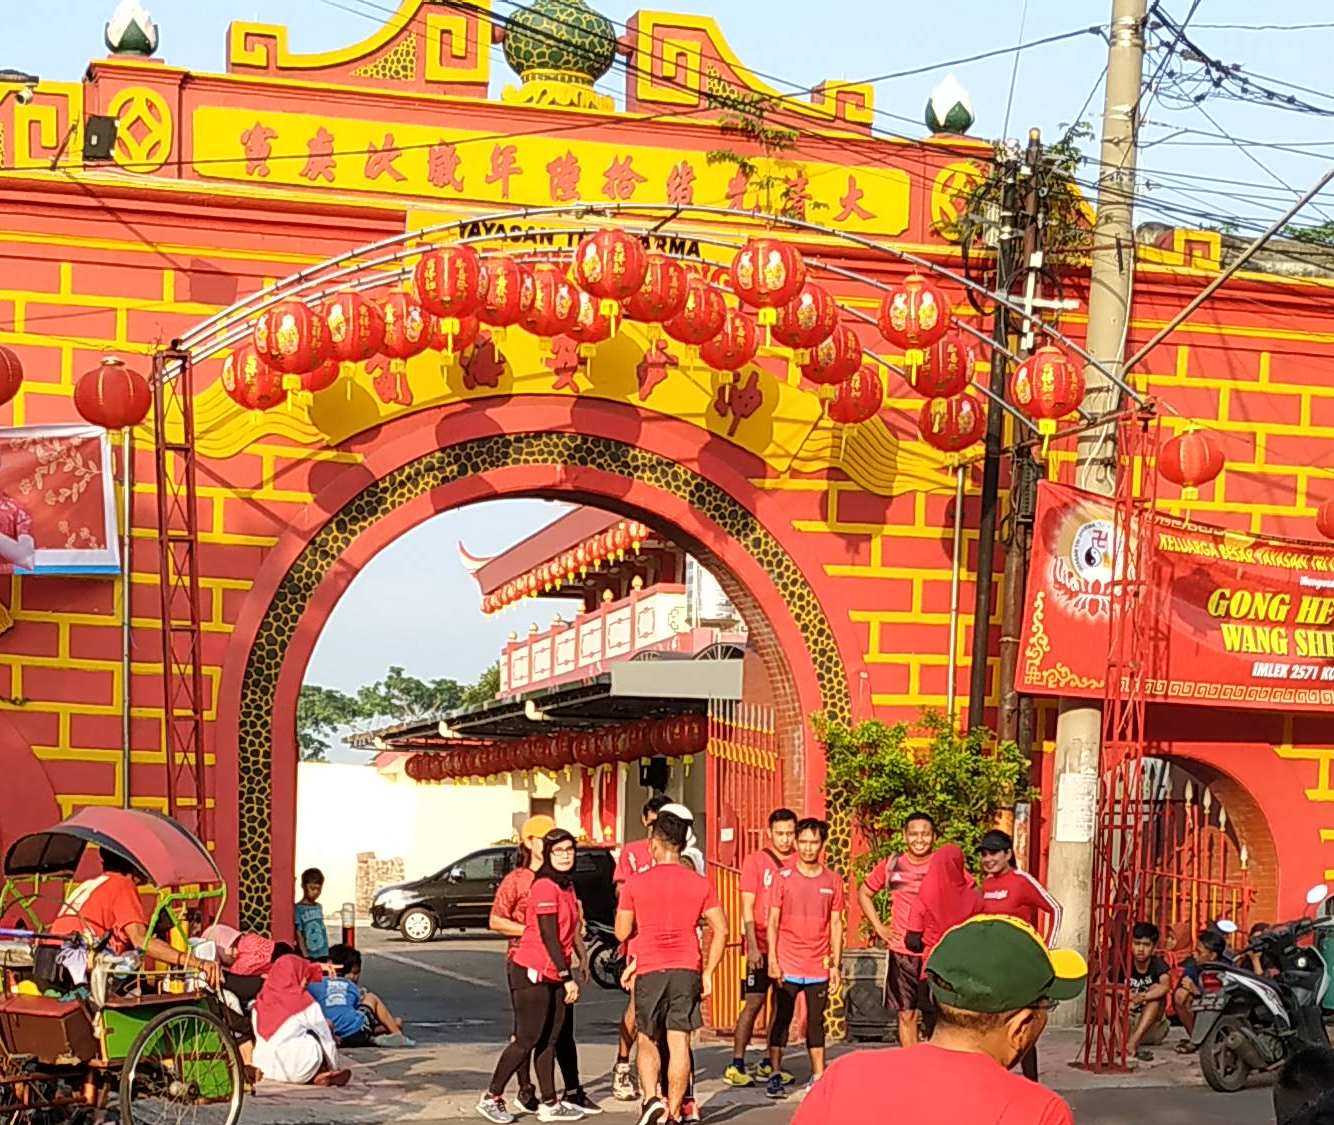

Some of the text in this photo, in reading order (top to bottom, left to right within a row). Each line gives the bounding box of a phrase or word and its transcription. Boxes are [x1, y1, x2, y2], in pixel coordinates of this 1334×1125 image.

[1158, 533, 1220, 559] KELUARGA
[1219, 544, 1256, 564] BESAR
[1254, 550, 1309, 569] YAYASAN
[1207, 588, 1291, 623] GONG
[1220, 623, 1289, 656] WANG
[1251, 661, 1290, 678] IMLEK
[1290, 664, 1318, 680] 2571
